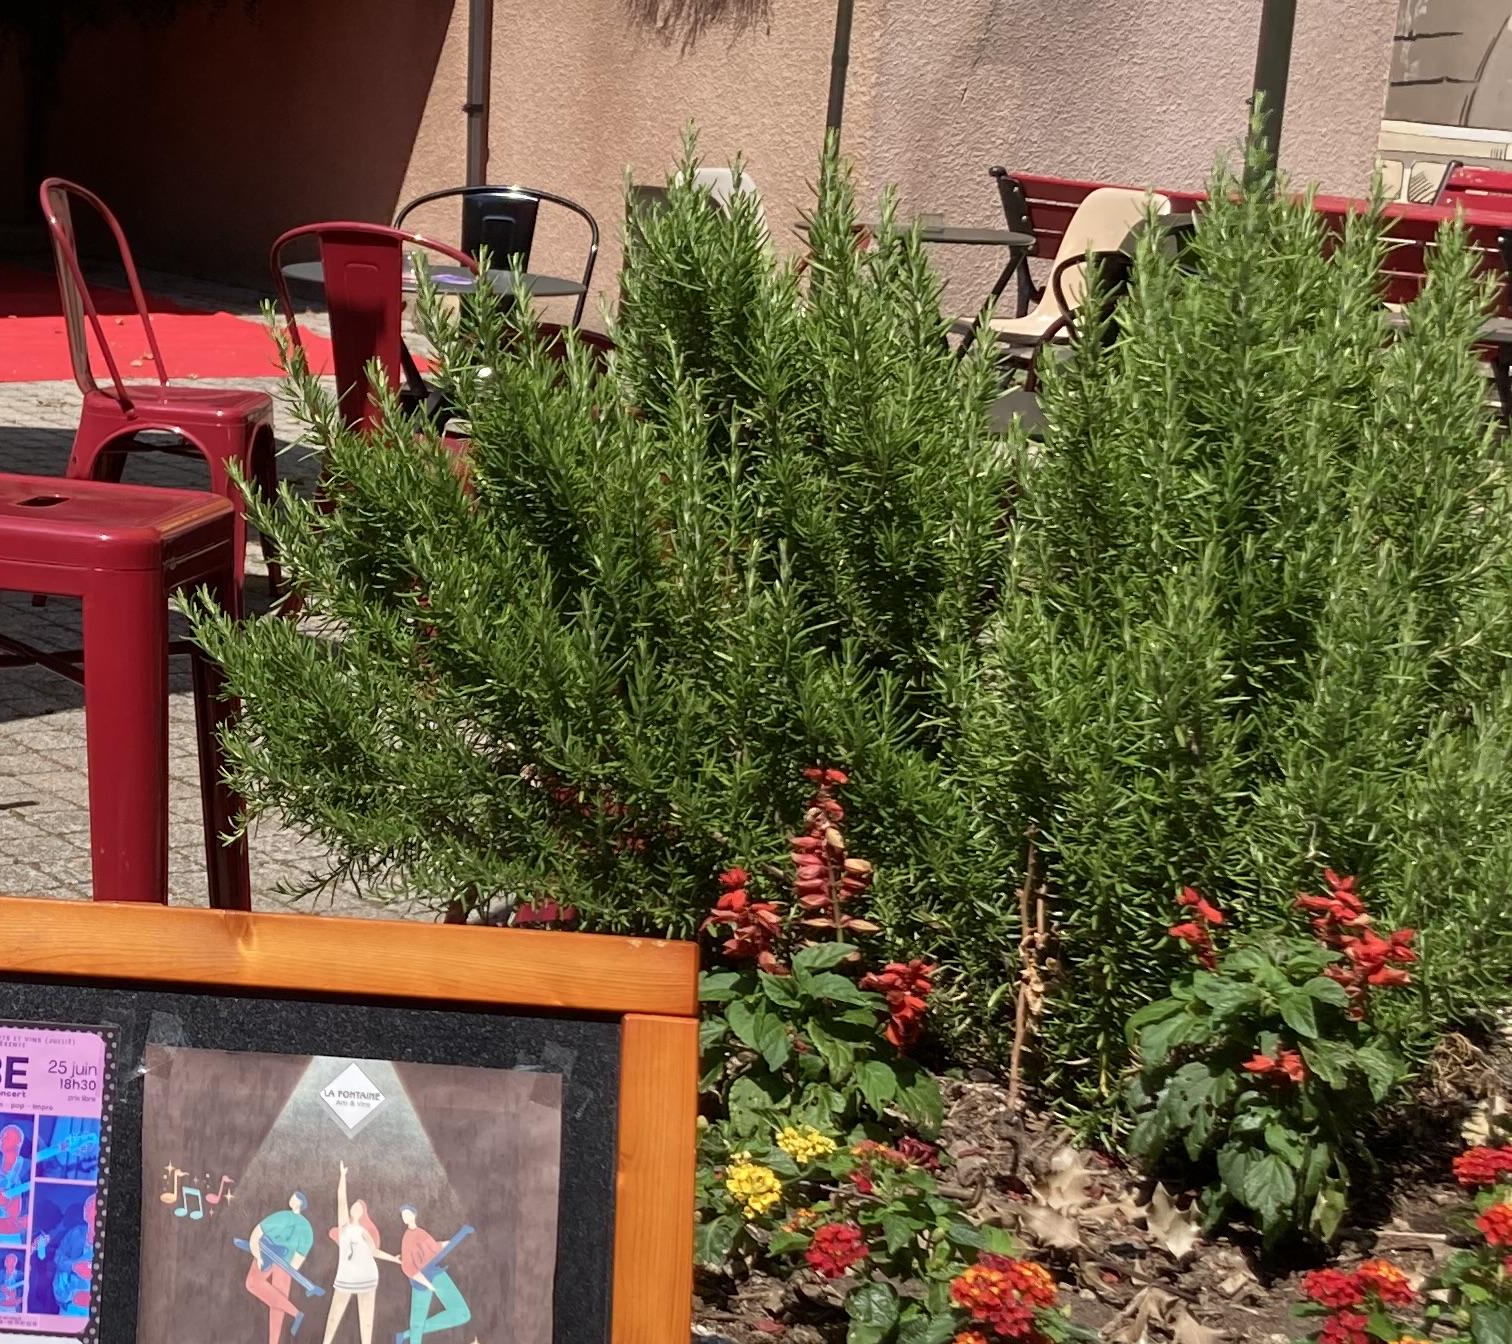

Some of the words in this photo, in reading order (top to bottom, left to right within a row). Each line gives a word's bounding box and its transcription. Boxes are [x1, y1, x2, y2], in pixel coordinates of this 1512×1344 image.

[48, 1059, 67, 1074] 25
[71, 1063, 98, 1077] juin
[60, 1078, 96, 1091] 18h30
